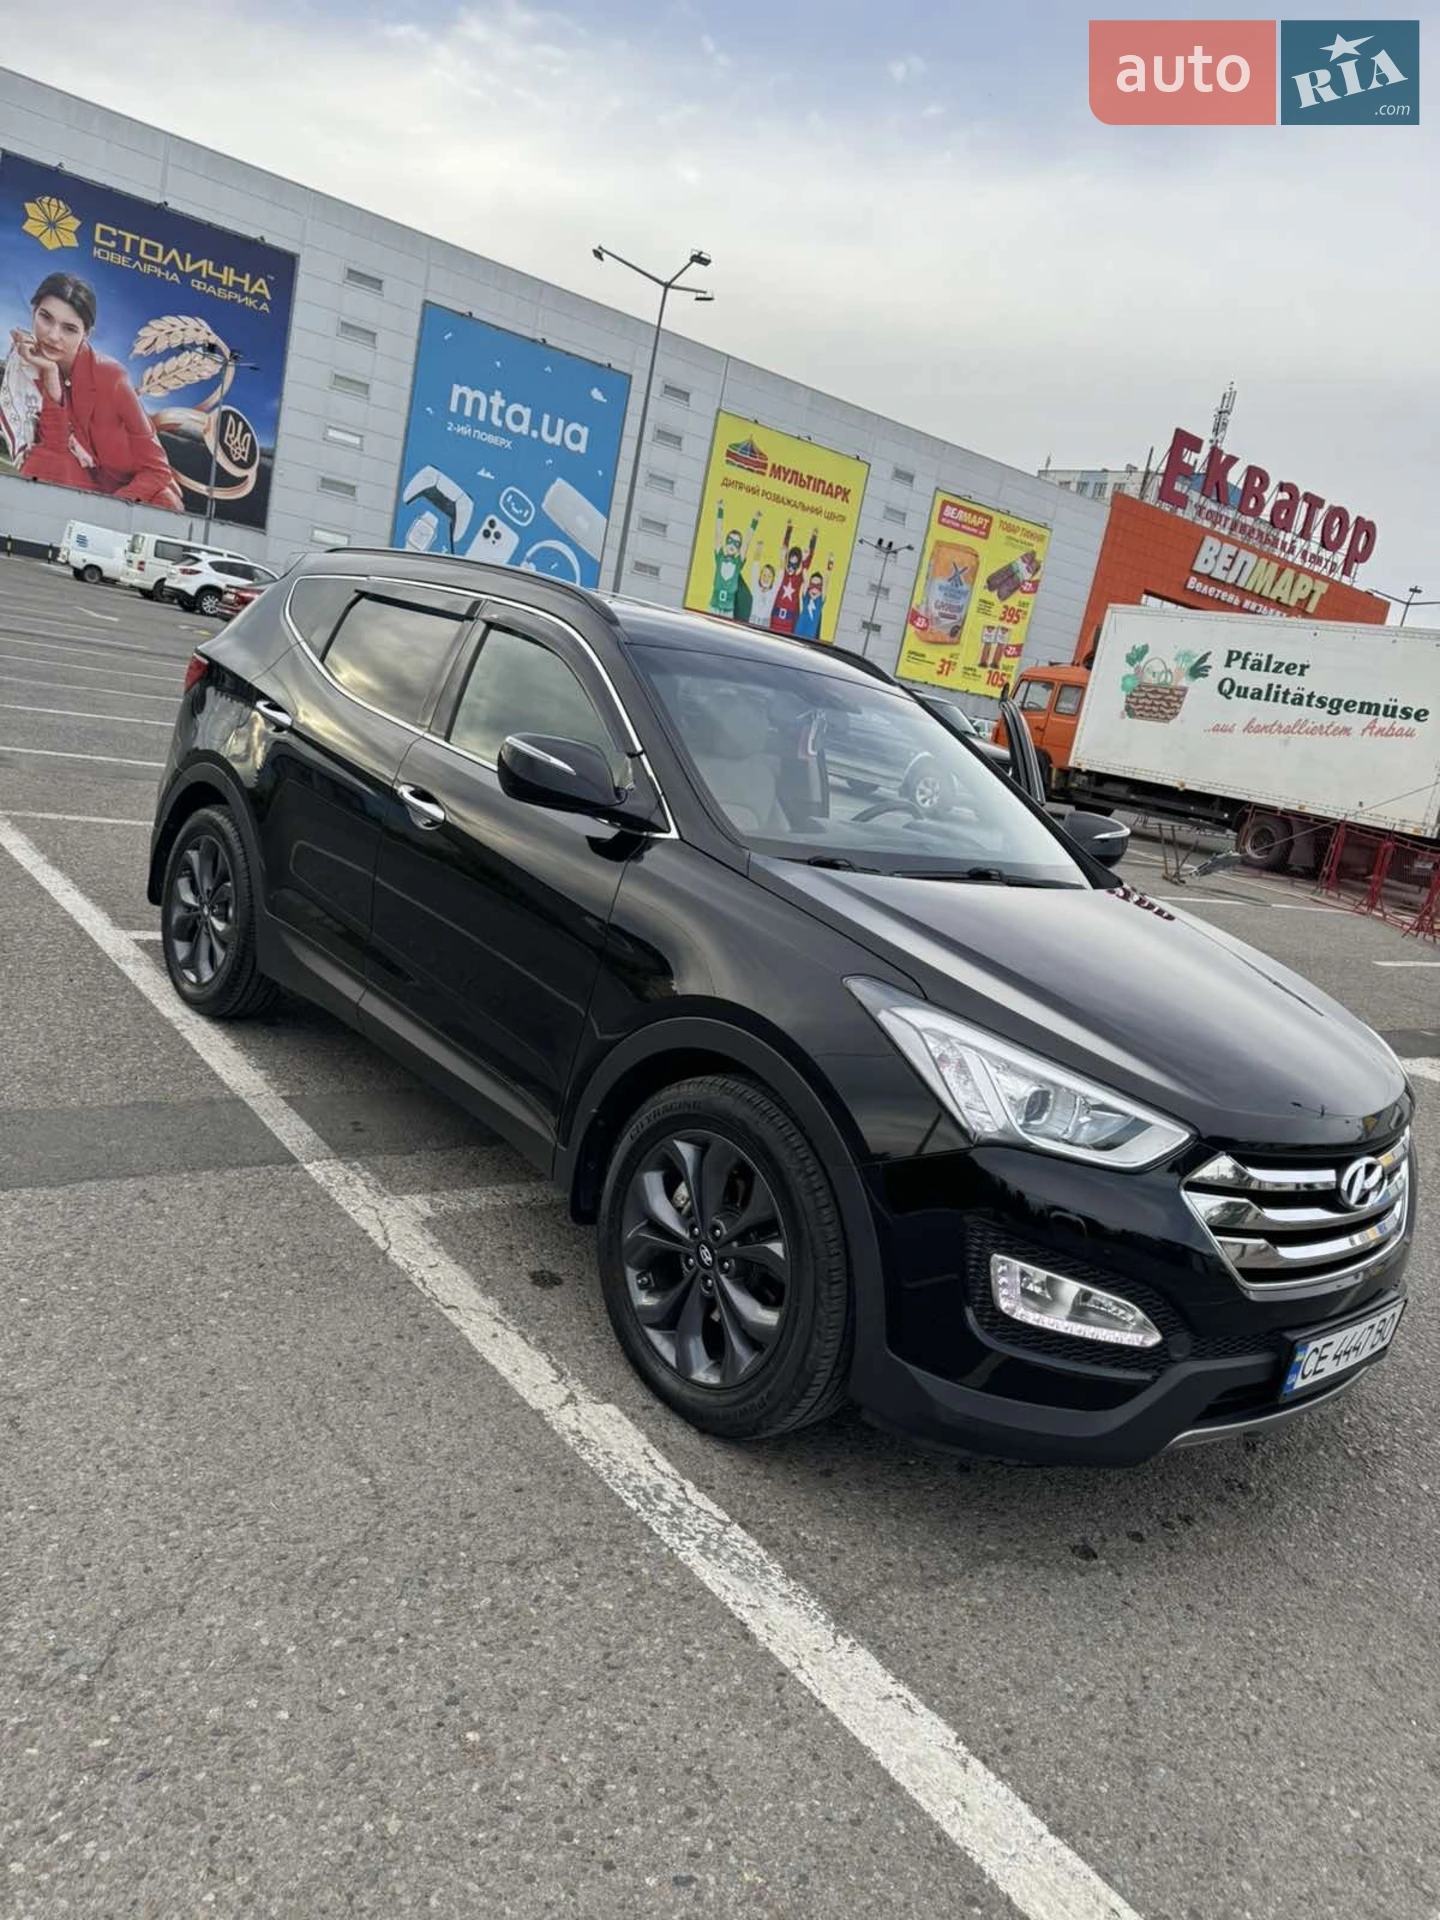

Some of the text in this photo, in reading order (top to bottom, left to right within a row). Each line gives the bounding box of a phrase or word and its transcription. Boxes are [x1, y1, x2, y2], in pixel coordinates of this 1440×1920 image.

[93, 246, 270, 313] ЮВЕЛІРНА ФАБРИКА
[94, 222, 272, 300] СТОЛИЧНА
[449, 383, 589, 454] mta.ua
[472, 429, 513, 450] ПОВЕРХ
[720, 477, 846, 522] ДИТЯЧИЙ РОЗВАЖАЛЬНИЙ ЦЕНТР
[769, 462, 851, 503] МУЛЬТІПАРК
[943, 505, 990, 529] ВЕЛМАРТ
[1191, 535, 1329, 614] ВЕЛМАРТ
[1224, 649, 1311, 677] Pfälzer
[1217, 677, 1430, 723] Qualitätsgemüse
[1242, 717, 1353, 738] kontrolliertem
[1360, 717, 1418, 738] Anbau
[1301, 1341, 1334, 1380] CE
